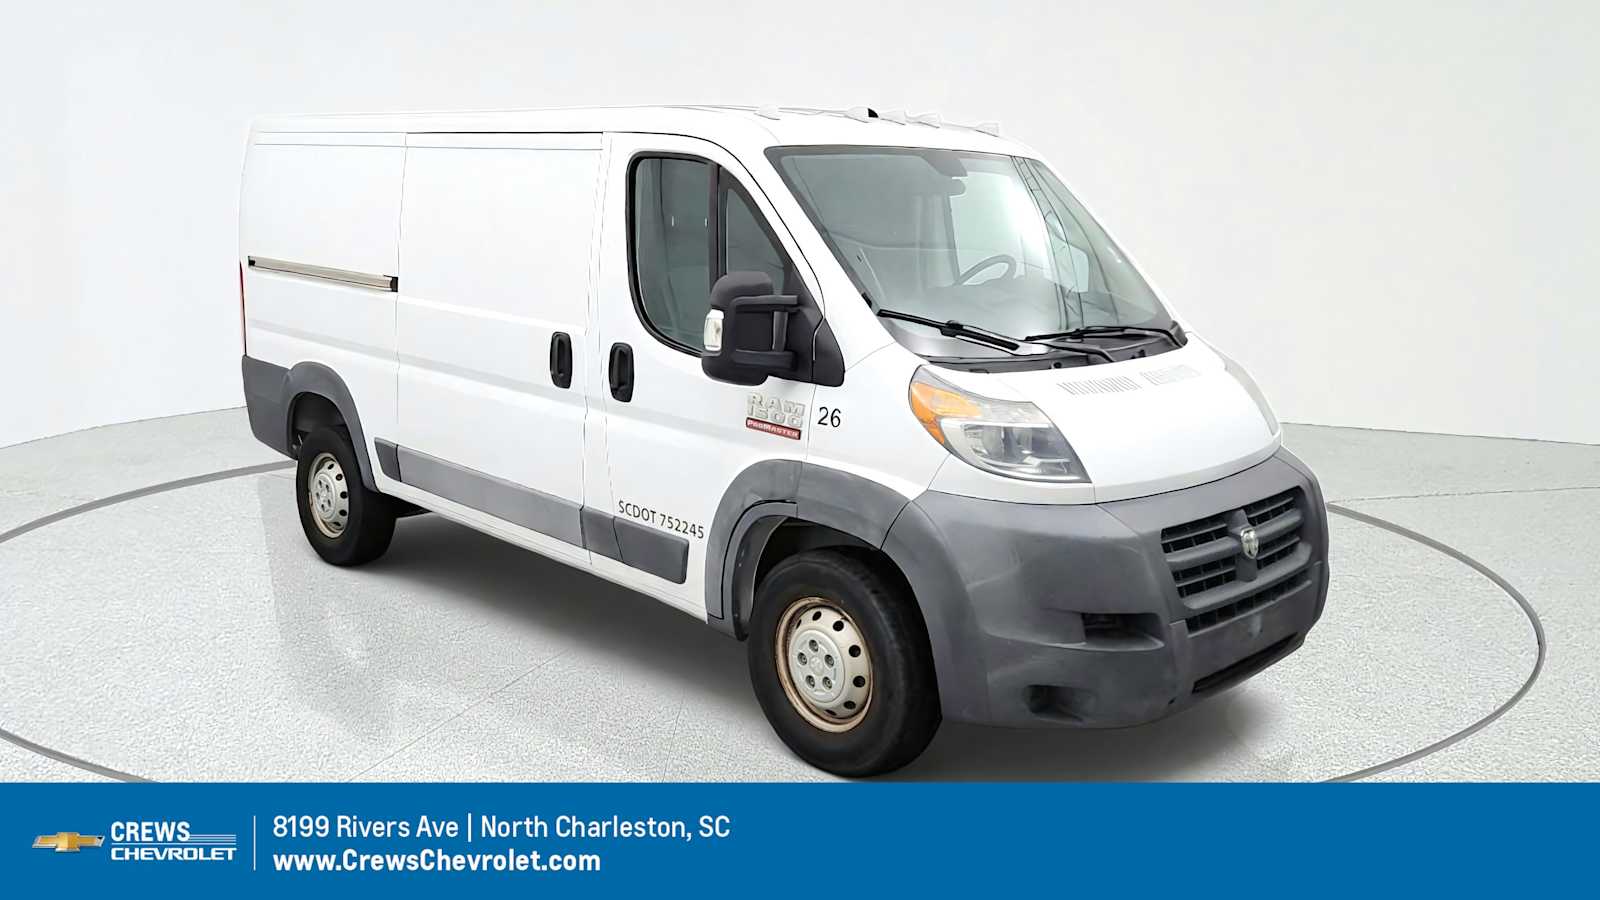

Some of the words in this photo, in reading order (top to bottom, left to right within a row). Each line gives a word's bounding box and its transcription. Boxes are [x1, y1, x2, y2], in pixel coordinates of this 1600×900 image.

[747, 392, 806, 416] RAM
[747, 406, 803, 428] 1500
[817, 406, 842, 428] 26
[618, 500, 657, 524] SCDOT
[659, 513, 705, 540] 752245
